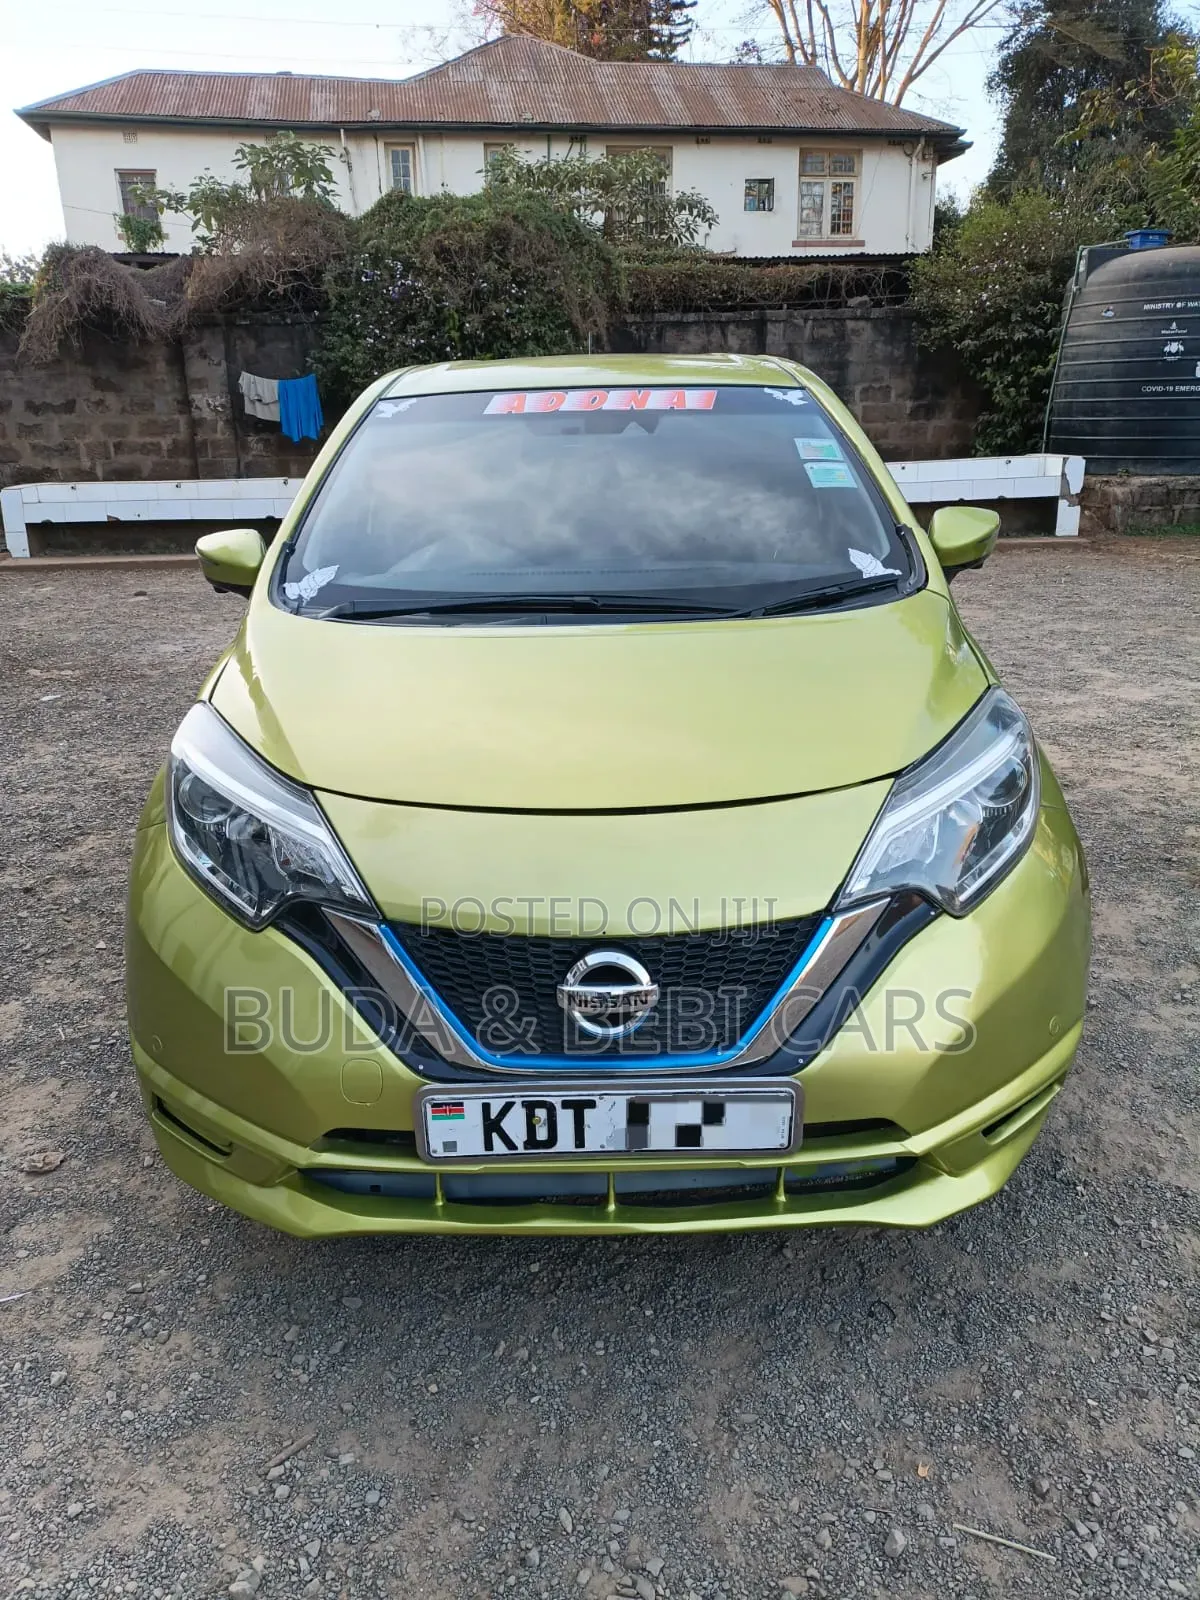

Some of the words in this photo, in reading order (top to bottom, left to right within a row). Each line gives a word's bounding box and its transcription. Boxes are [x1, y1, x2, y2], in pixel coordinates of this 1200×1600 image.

[1144, 302, 1175, 310] MINISTRY
[567, 992, 649, 1009] NISSAN
[481, 1099, 597, 1152] KDT
